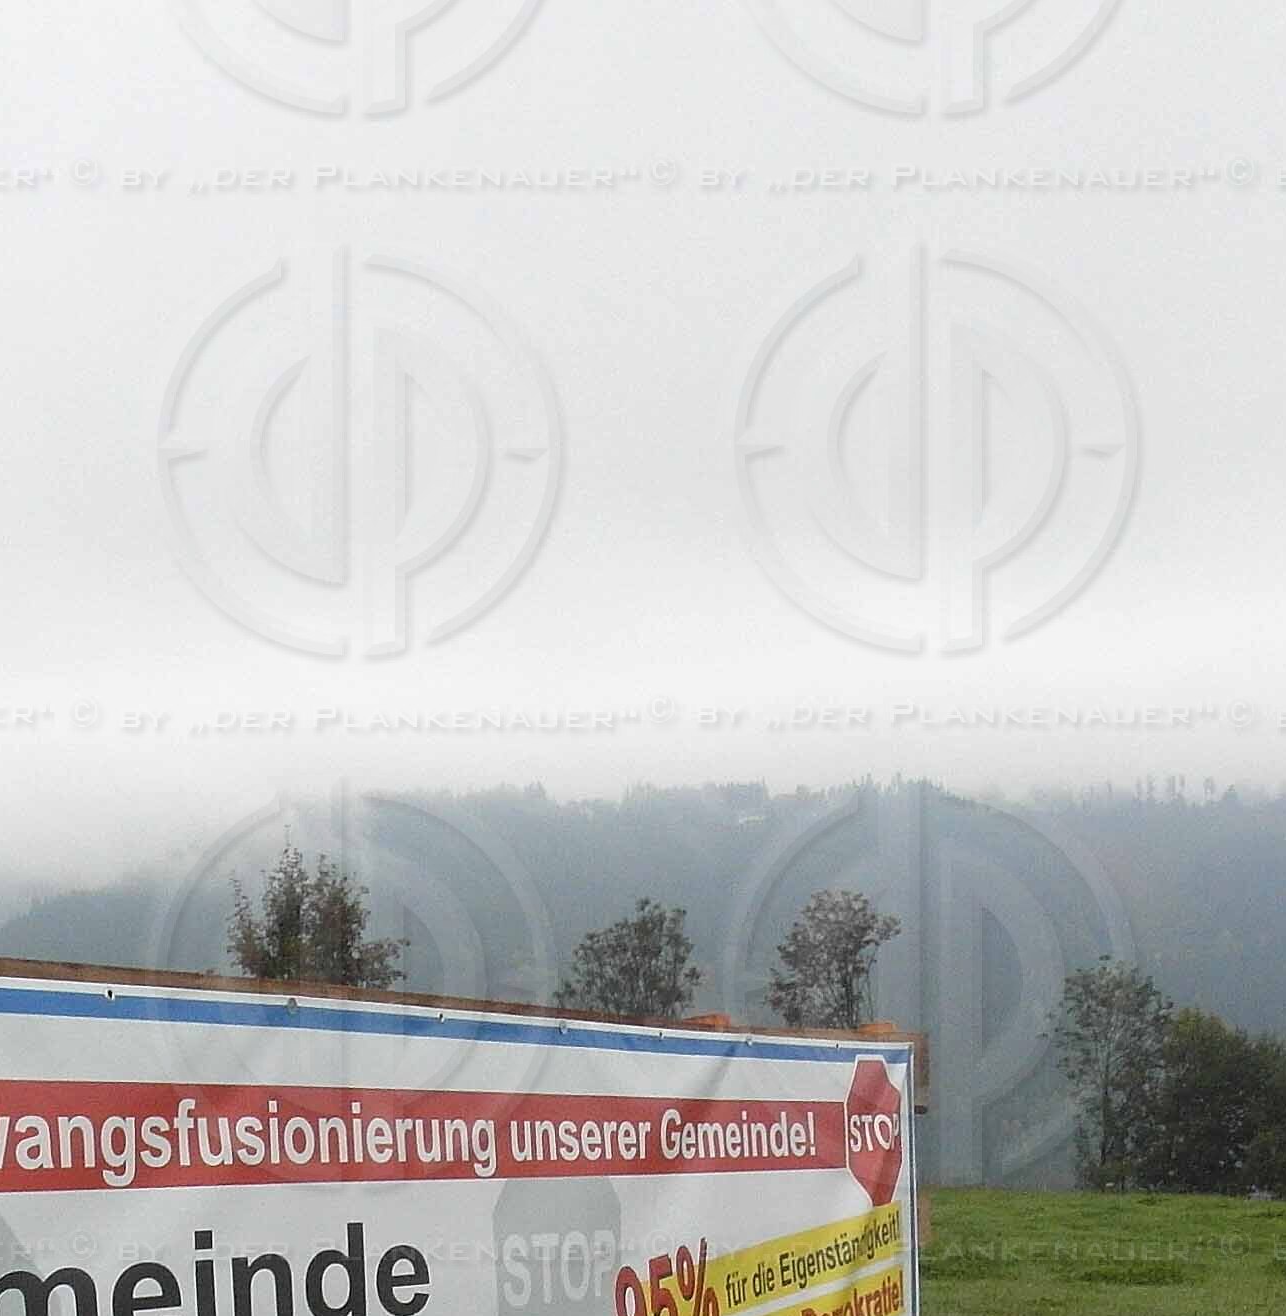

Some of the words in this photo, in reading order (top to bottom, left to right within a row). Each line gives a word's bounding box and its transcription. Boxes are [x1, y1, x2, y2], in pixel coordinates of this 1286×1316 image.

[509, 1118, 652, 1163] unserer
[660, 1107, 816, 1162] Gemeinde!
[849, 1113, 901, 1153] STOP
[725, 1269, 747, 1309] für
[752, 1262, 776, 1298] die
[778, 1211, 901, 1288] Eigenstängkeit!
